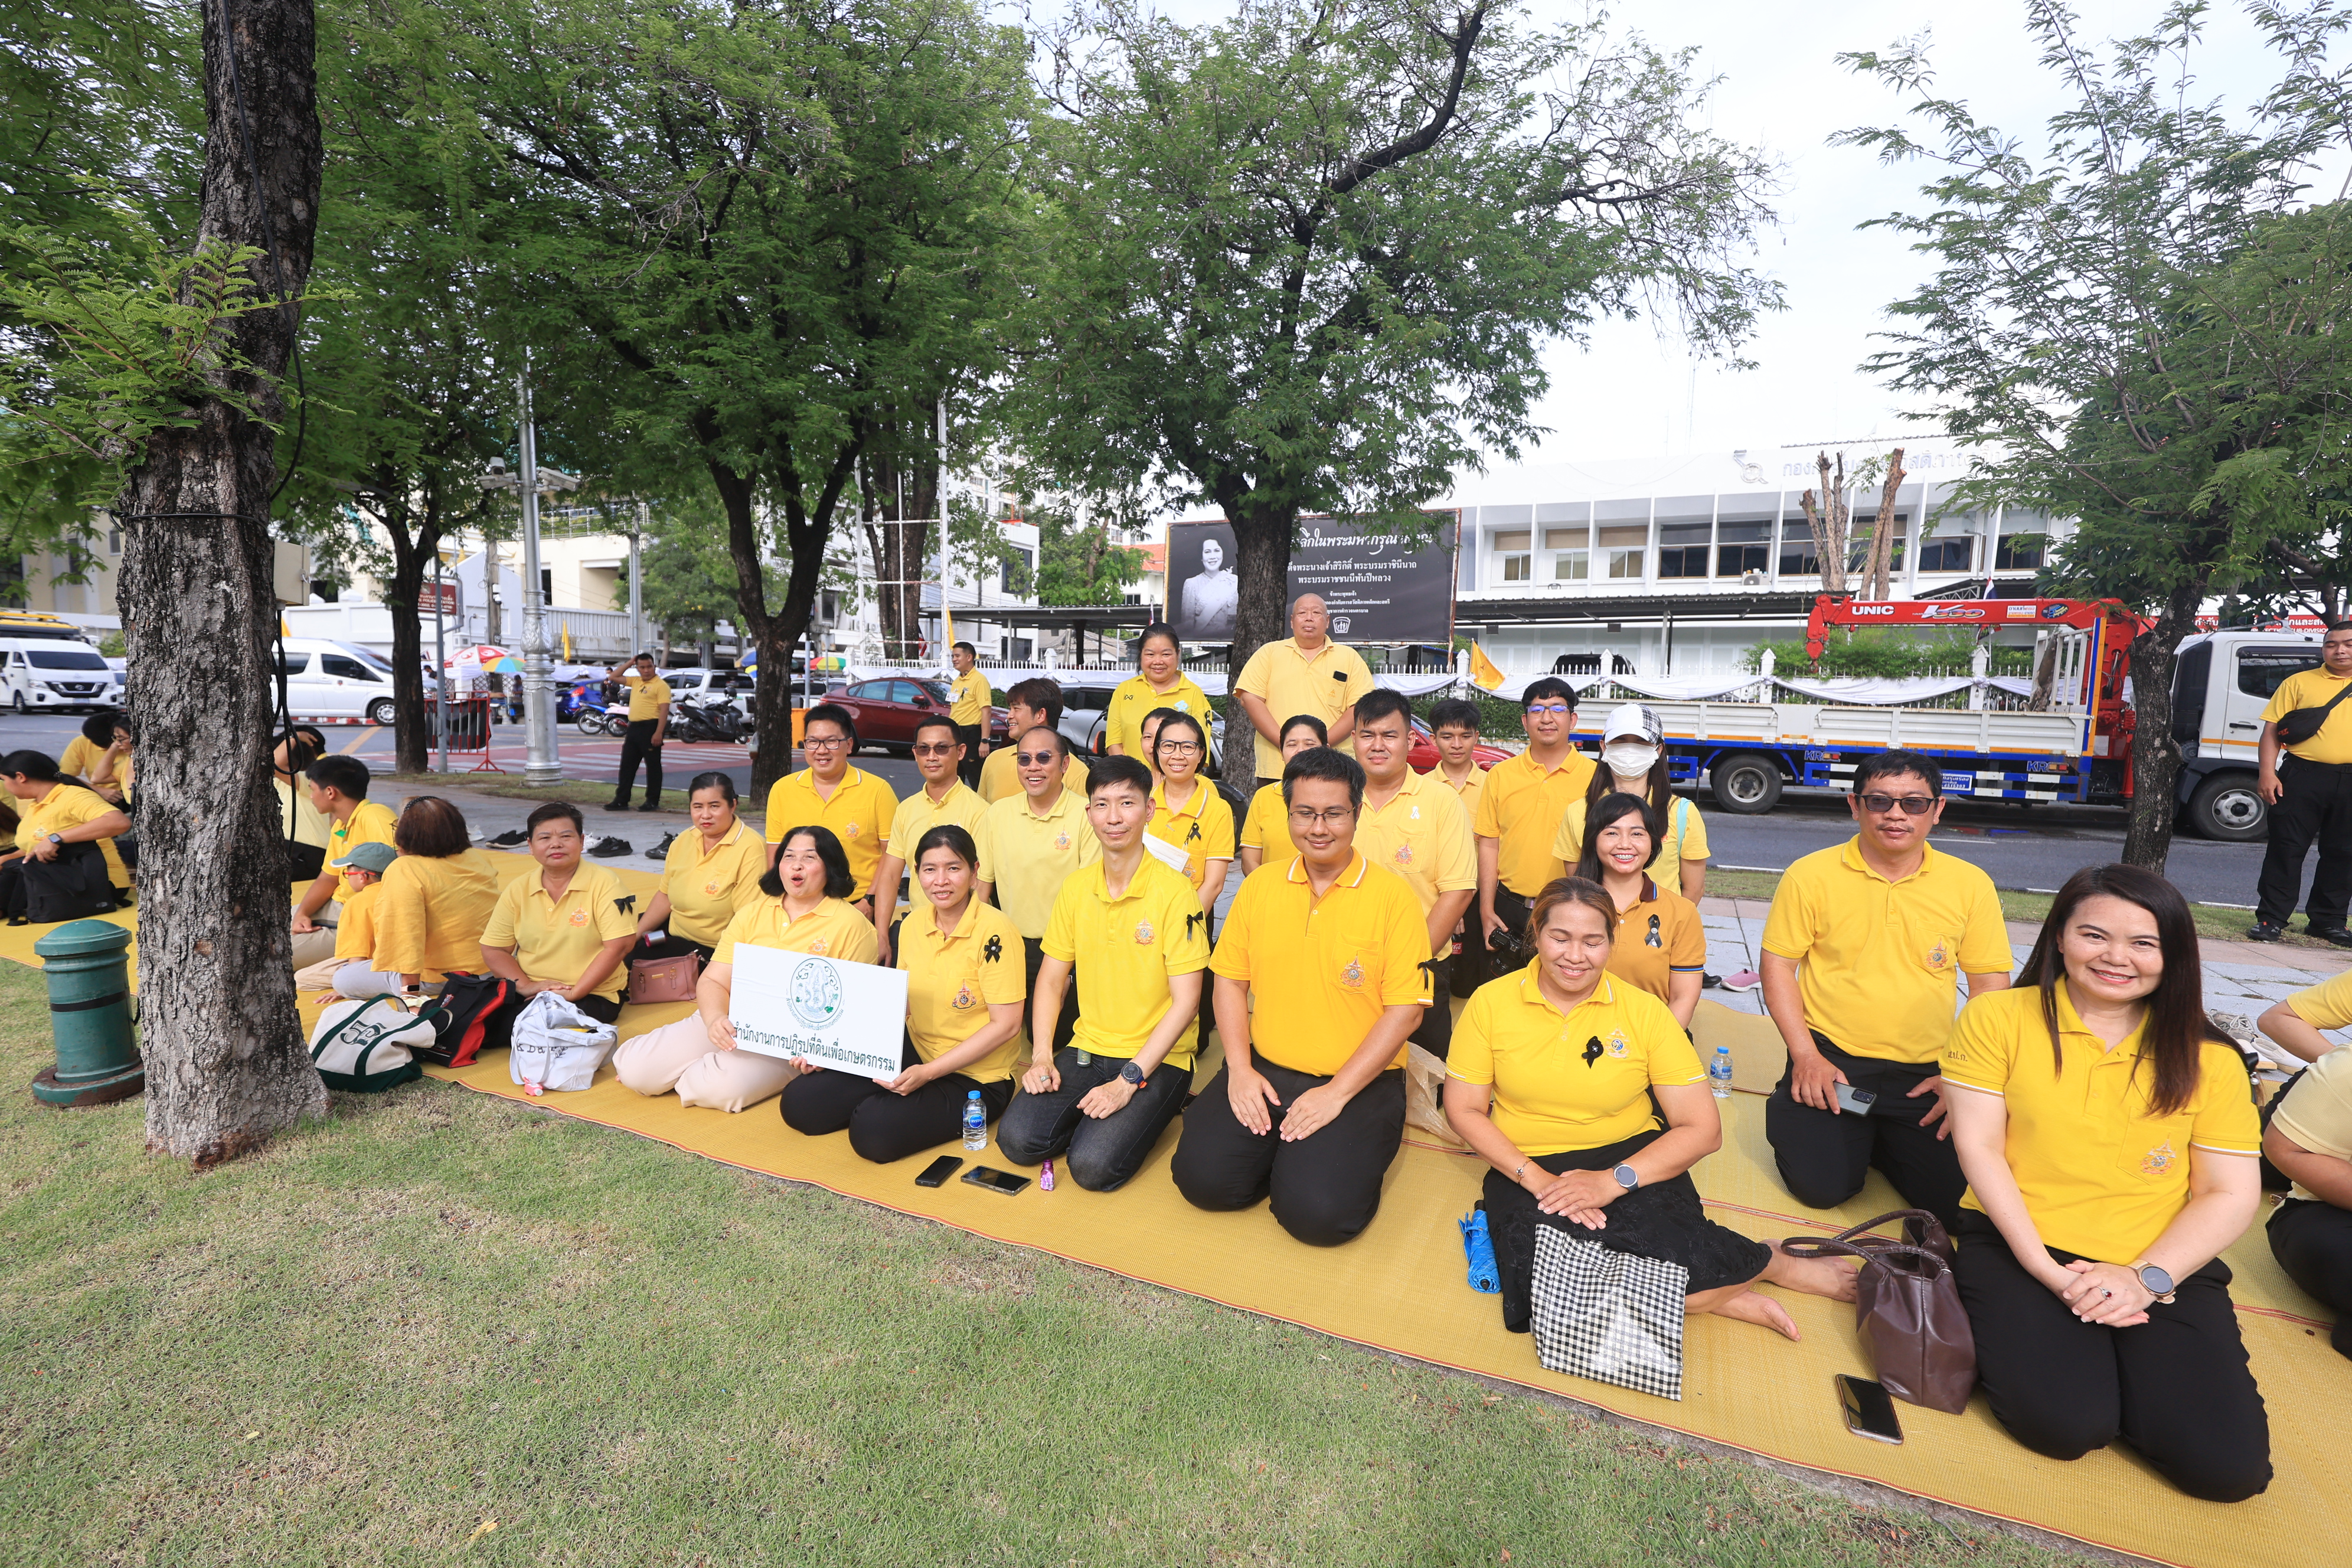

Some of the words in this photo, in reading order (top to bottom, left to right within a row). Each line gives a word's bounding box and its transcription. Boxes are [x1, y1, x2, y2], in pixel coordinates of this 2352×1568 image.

[1287, 557, 1353, 571] ด็จพระนางเจ้าสิริกิติ์
[1354, 559, 1417, 570] พระบรมราชินีนาถ
[1298, 573, 1391, 583] พระบรมราชชนนีพันปีหลวง
[1851, 605, 1894, 616] UNIC
